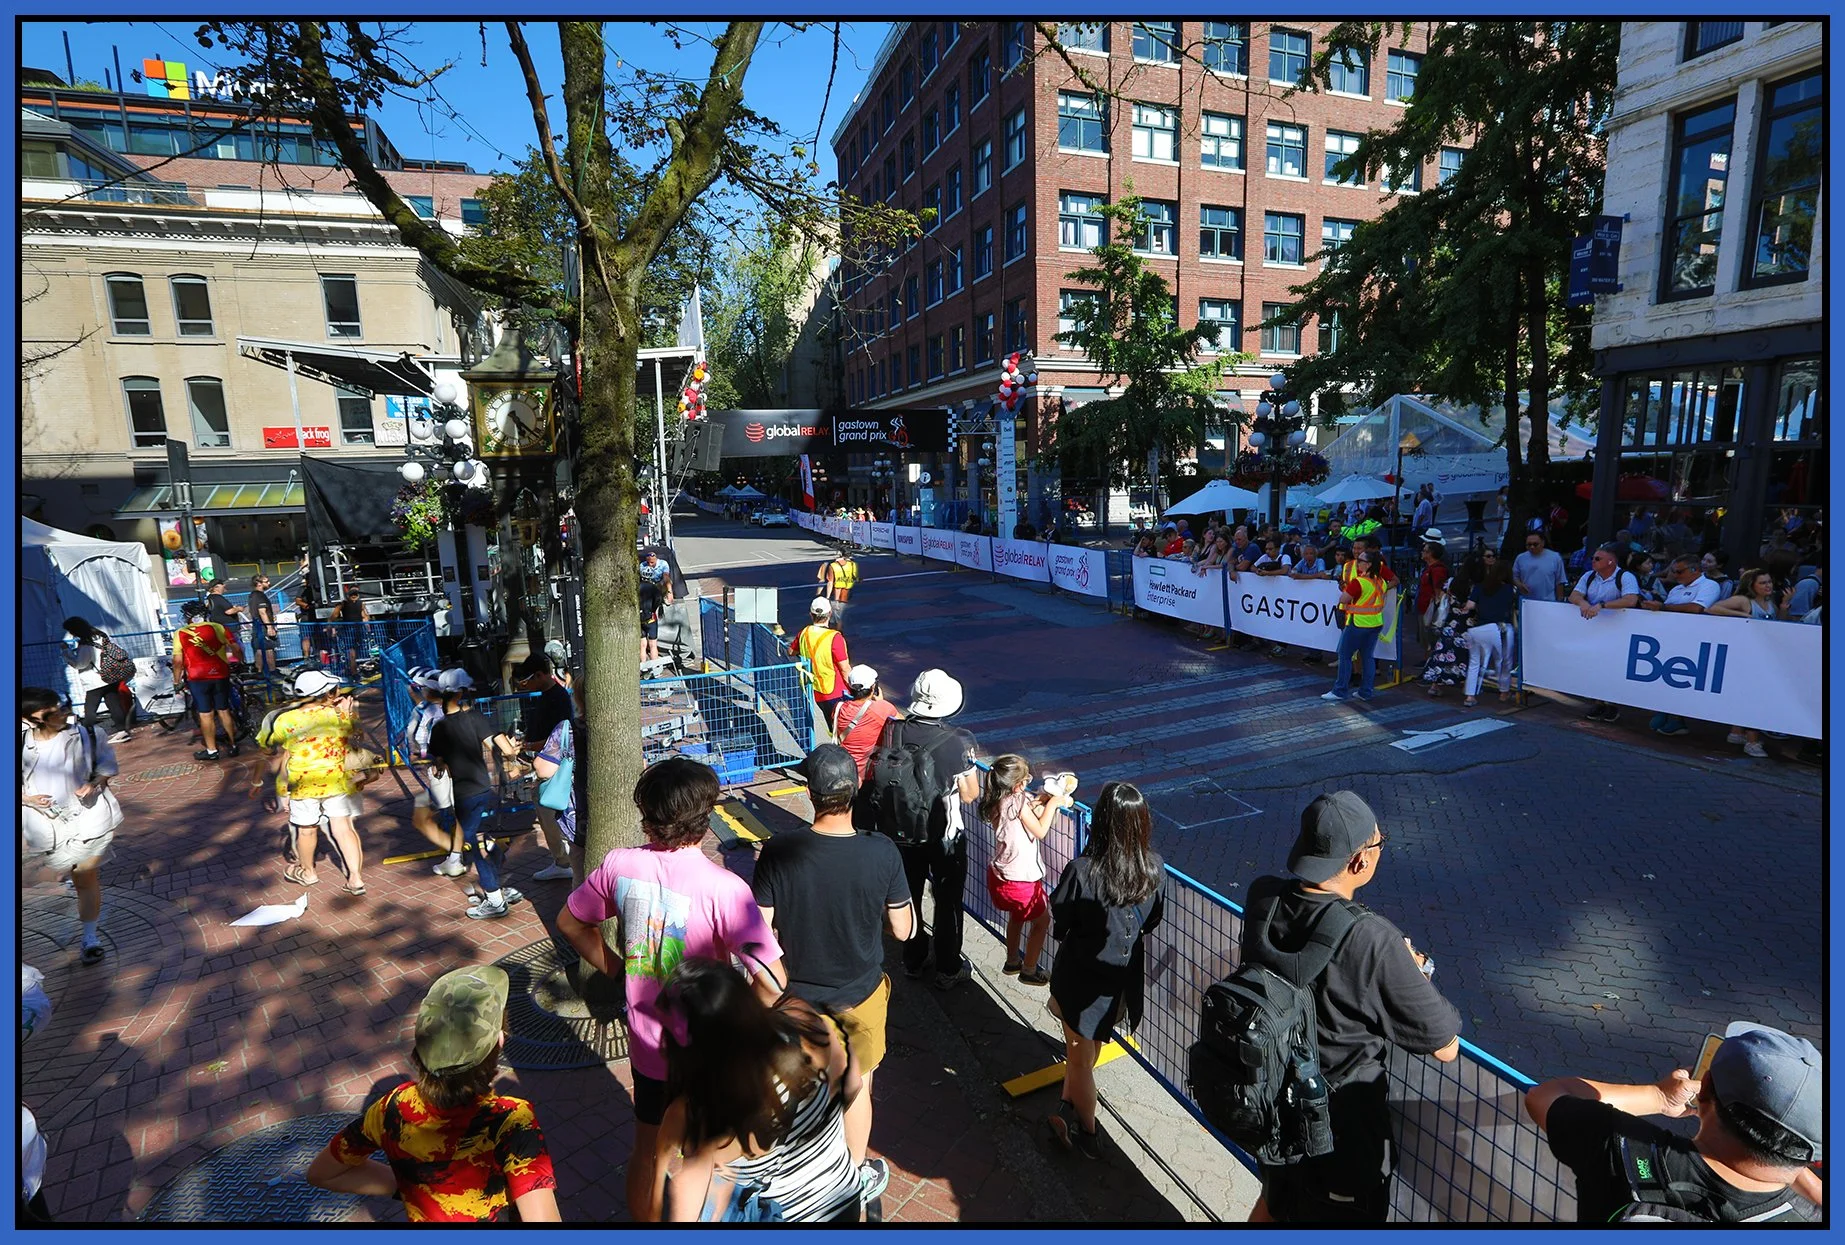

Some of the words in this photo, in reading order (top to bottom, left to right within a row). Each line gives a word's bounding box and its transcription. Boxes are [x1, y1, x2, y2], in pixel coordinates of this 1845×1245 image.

[838, 420, 879, 431] gastown
[839, 430, 868, 442] grand
[869, 430, 887, 442] prix
[1147, 590, 1176, 607] Enterprise
[1149, 579, 1171, 595] Hewlett
[1171, 583, 1197, 600] Packard
[1241, 594, 1340, 628] GASTOW
[1626, 634, 1728, 694] Bell
